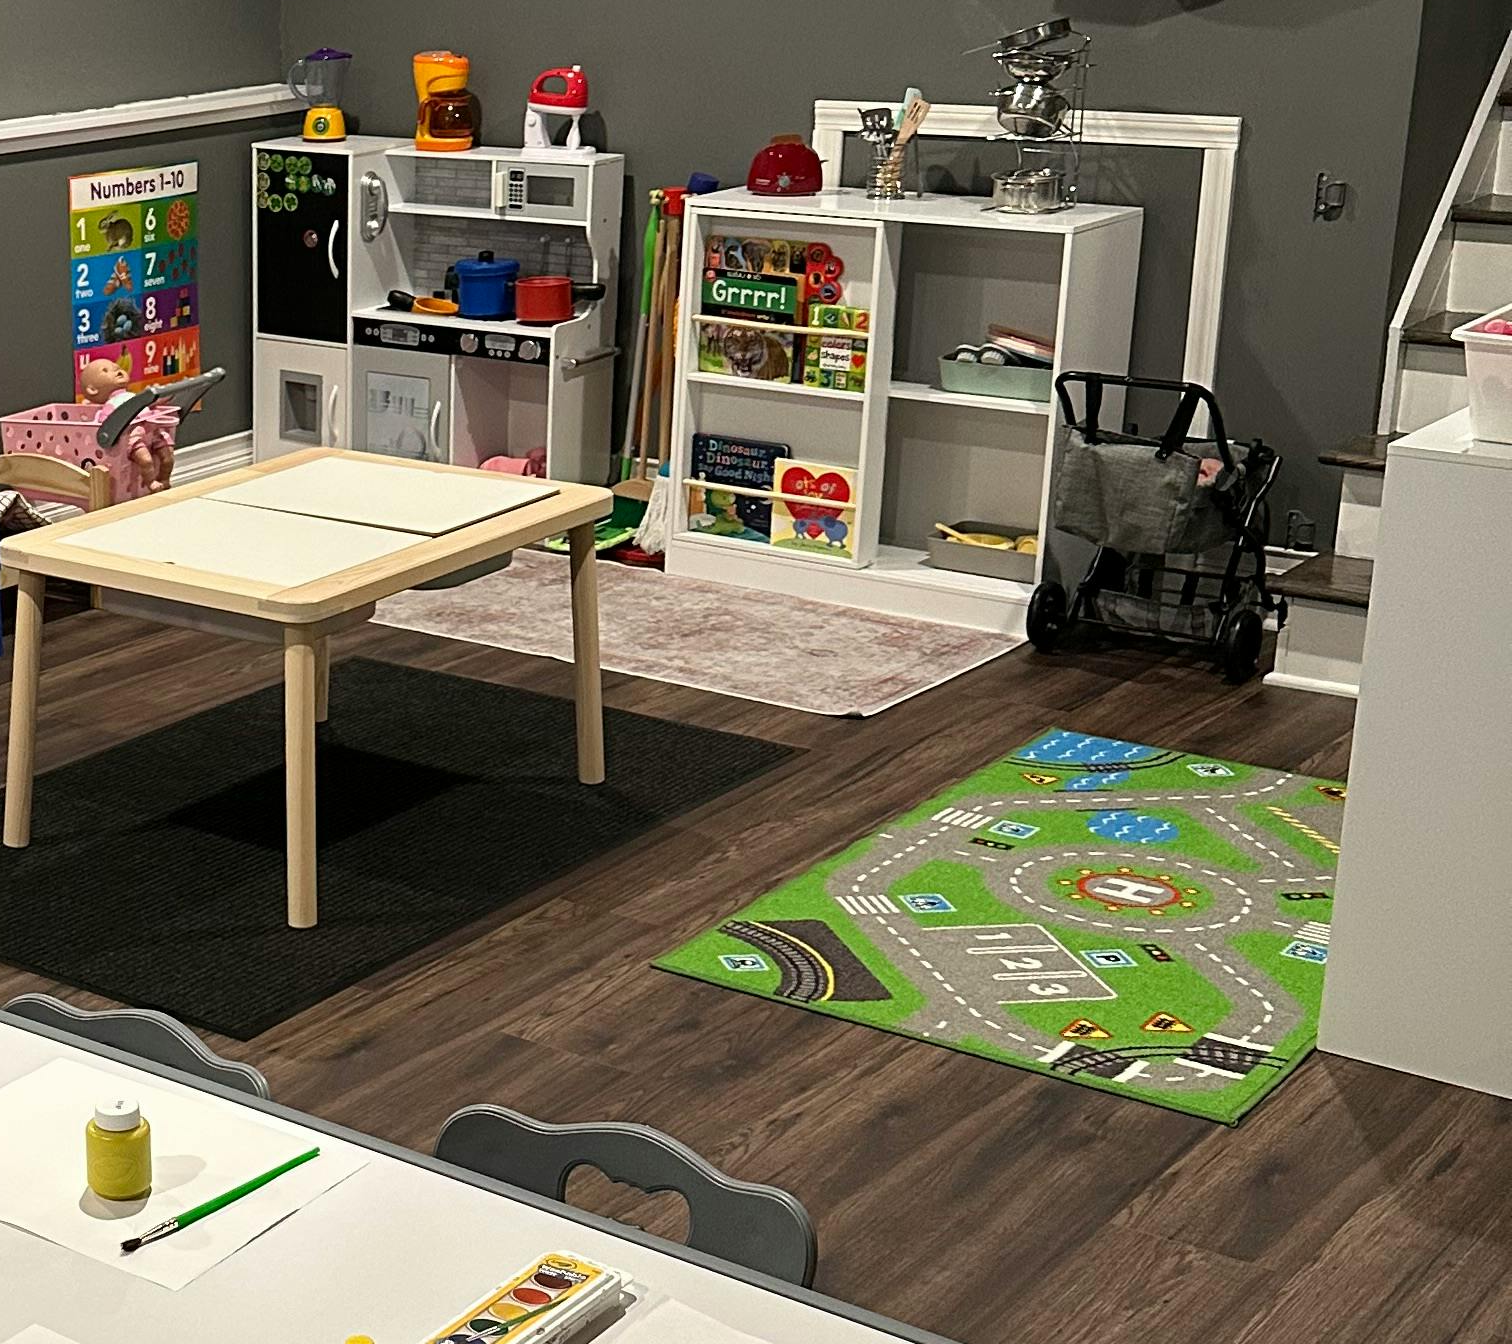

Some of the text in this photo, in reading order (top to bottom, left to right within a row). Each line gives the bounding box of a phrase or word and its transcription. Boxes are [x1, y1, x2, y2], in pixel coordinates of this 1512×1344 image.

[90, 170, 184, 200] Numbers 1-10
[145, 208, 156, 231] 6
[76, 218, 86, 241] 1
[144, 232, 155, 243] six
[74, 244, 91, 253] one
[145, 252, 156, 275] 7
[77, 264, 89, 287] 2
[143, 276, 165, 287] seven
[75, 289, 93, 298] two
[712, 280, 786, 310] Grrrr!
[145, 296, 156, 320] 8
[78, 309, 90, 332] 3
[143, 319, 163, 333] eight
[77, 332, 99, 344] three
[145, 341, 156, 363] 9
[714, 467, 743, 479] Good
[744, 470, 772, 483] Nigh
[1092, 878, 1165, 903] H
[975, 932, 1013, 940] 1
[999, 958, 1043, 970] 2
[1027, 983, 1070, 995] 3
